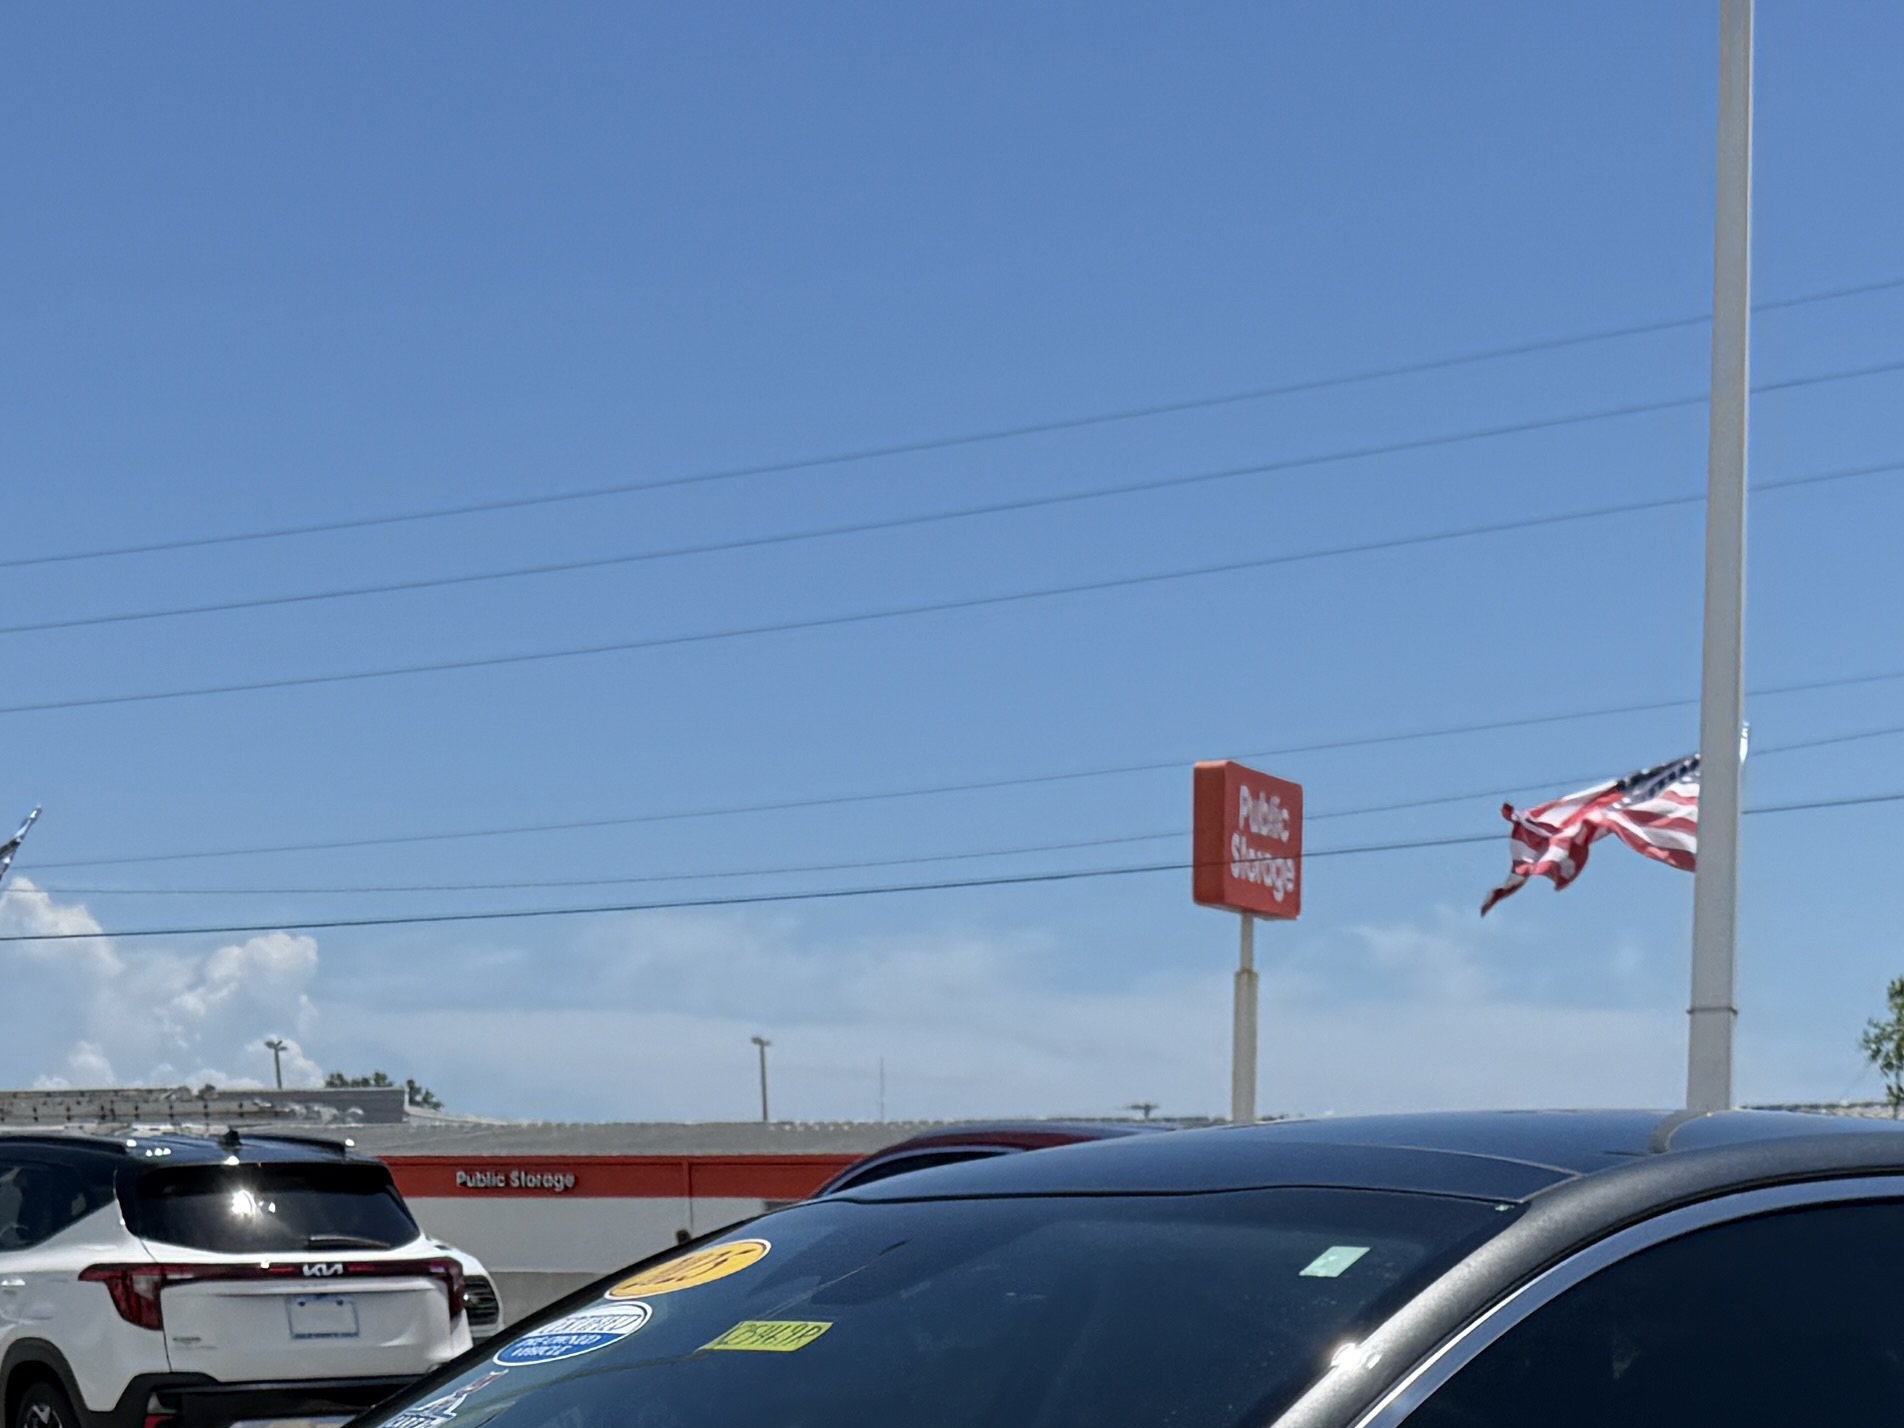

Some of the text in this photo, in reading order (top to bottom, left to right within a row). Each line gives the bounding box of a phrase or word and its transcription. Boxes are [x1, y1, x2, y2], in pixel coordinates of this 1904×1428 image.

[1239, 784, 1290, 843] Public
[1230, 832, 1295, 903] Storage
[456, 1170, 575, 1193] Public Storage
[302, 1263, 344, 1277] KIA
